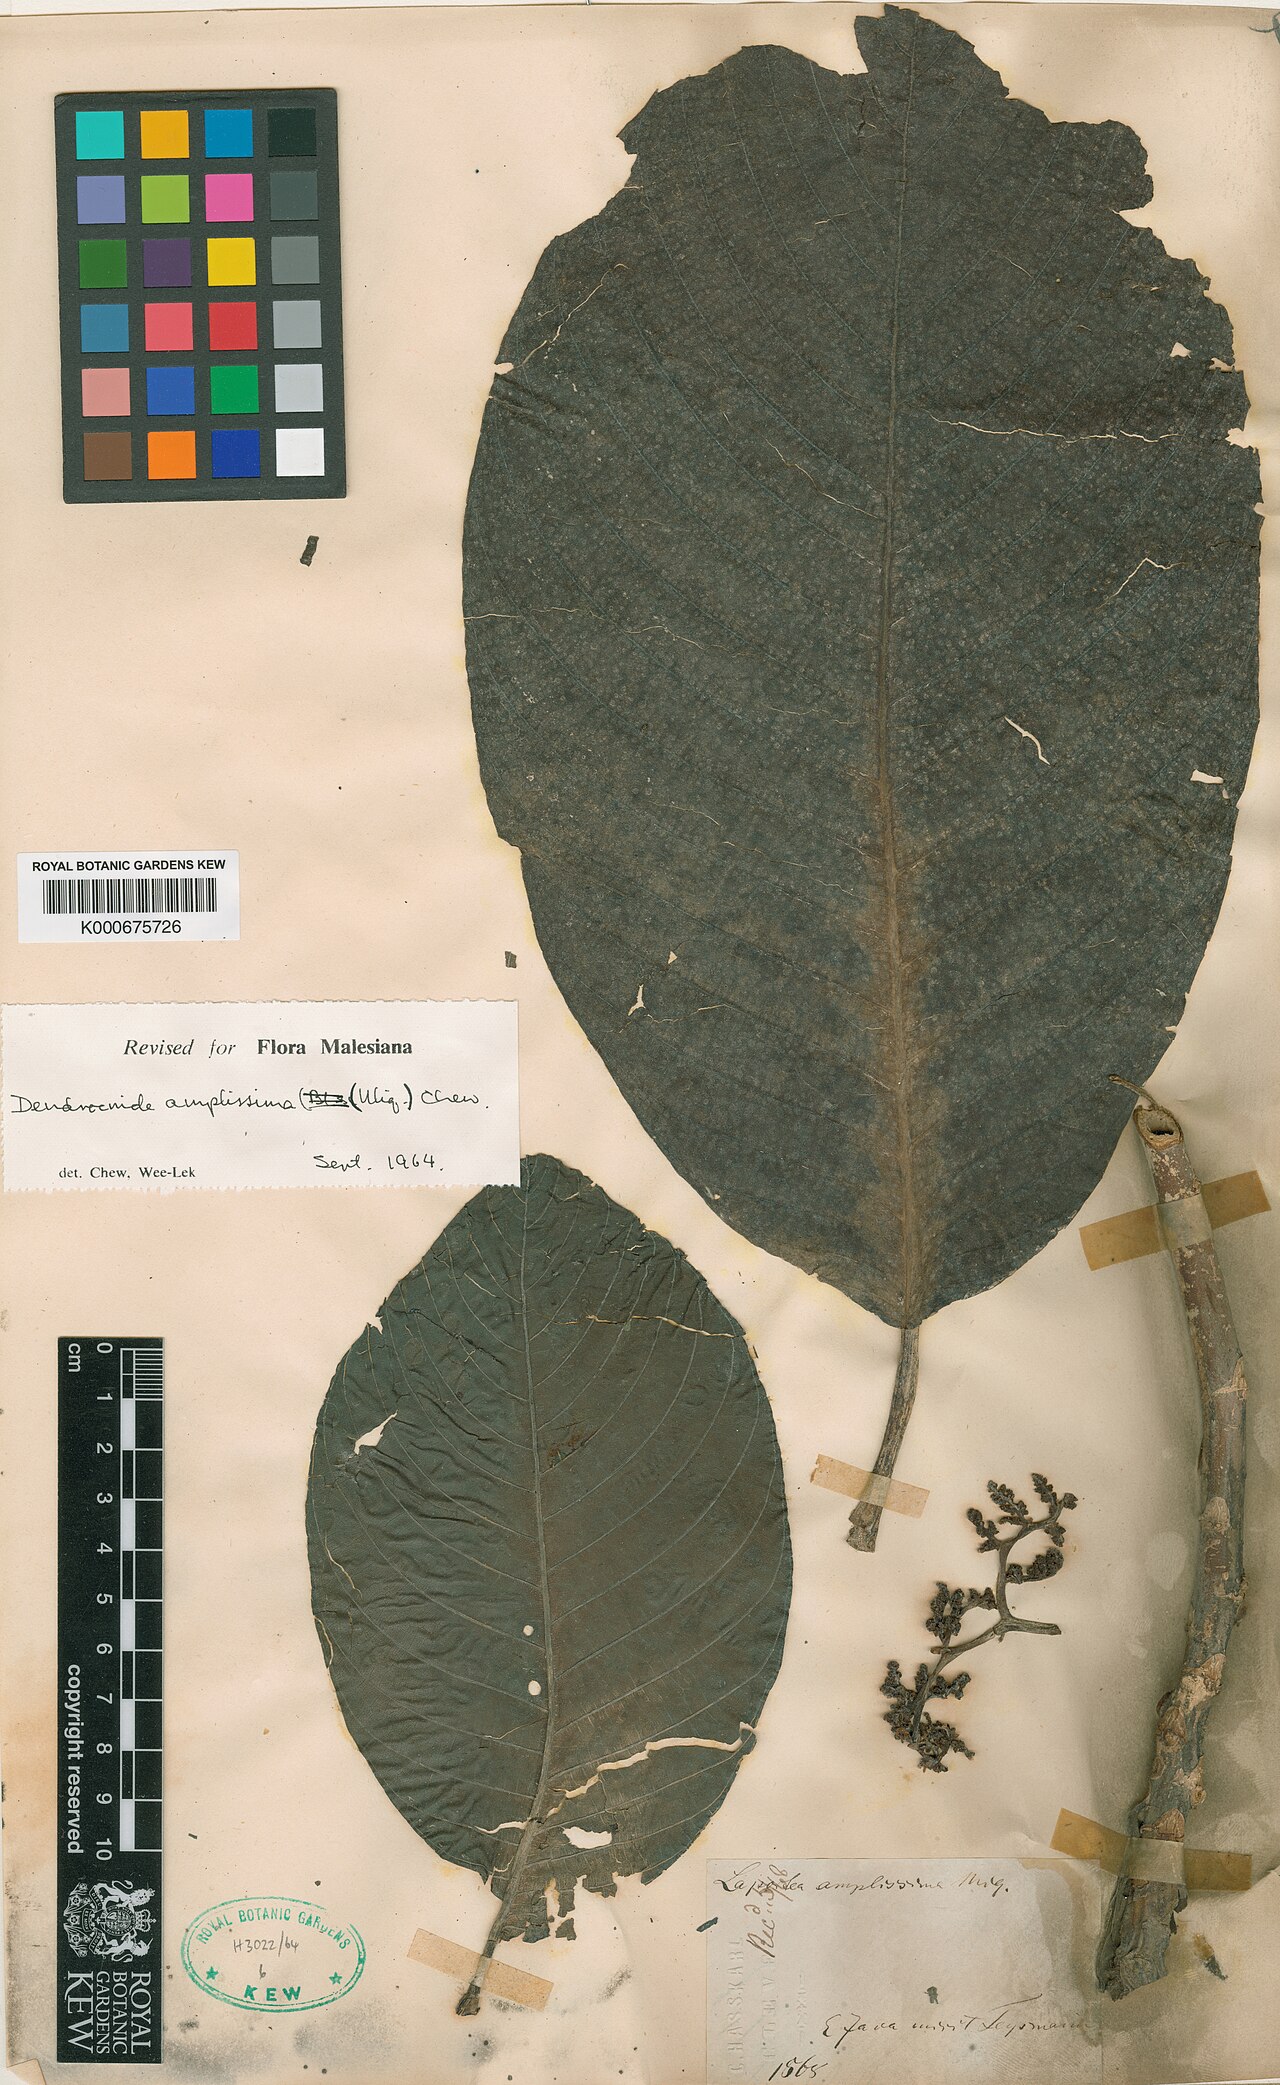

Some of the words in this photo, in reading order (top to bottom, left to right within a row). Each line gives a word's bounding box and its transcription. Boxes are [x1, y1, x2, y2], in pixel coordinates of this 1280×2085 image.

[33, 862, 73, 871] ROYAL
[77, 861, 130, 871] BOTANIC
[134, 860, 194, 870] GARDENS
[198, 860, 226, 869] KEW
[82, 920, 181, 934] K000675726
[124, 1039, 194, 1055] Revised
[209, 1039, 236, 1058] for
[258, 1039, 306, 1054] Flora
[321, 1038, 412, 1054] Malesiana
[166, 1089, 296, 1117] amplissima
[59, 1167, 82, 1178] det.
[90, 1167, 130, 1178] Chew,
[139, 1167, 195, 1178] Wee-Lek
[97, 1343, 112, 1353] 0
[69, 1344, 80, 1372] cm
[97, 1443, 112, 1453] 2
[97, 1493, 112, 1503] 3
[97, 1543, 112, 1554] 4
[97, 1593, 112, 1604] 5
[97, 1644, 112, 1654] 6
[97, 1693, 112, 1704] 7
[65, 1665, 84, 1759] copyright
[97, 1743, 112, 1754] 8
[97, 1794, 112, 1804] 9
[68, 1766, 83, 1853] reserved
[97, 1838, 112, 1860] 10
[196, 1915, 233, 1944] ROYAL
[238, 1908, 291, 1923] BOTANIC
[298, 1911, 351, 1950] GARDENS
[243, 1984, 302, 2003] KEW
[65, 1971, 93, 2053] KEW
[95, 1971, 109, 2053] GARDENS
[113, 1972, 127, 2053] BOTANIC
[129, 1972, 151, 2054] ROYAL
